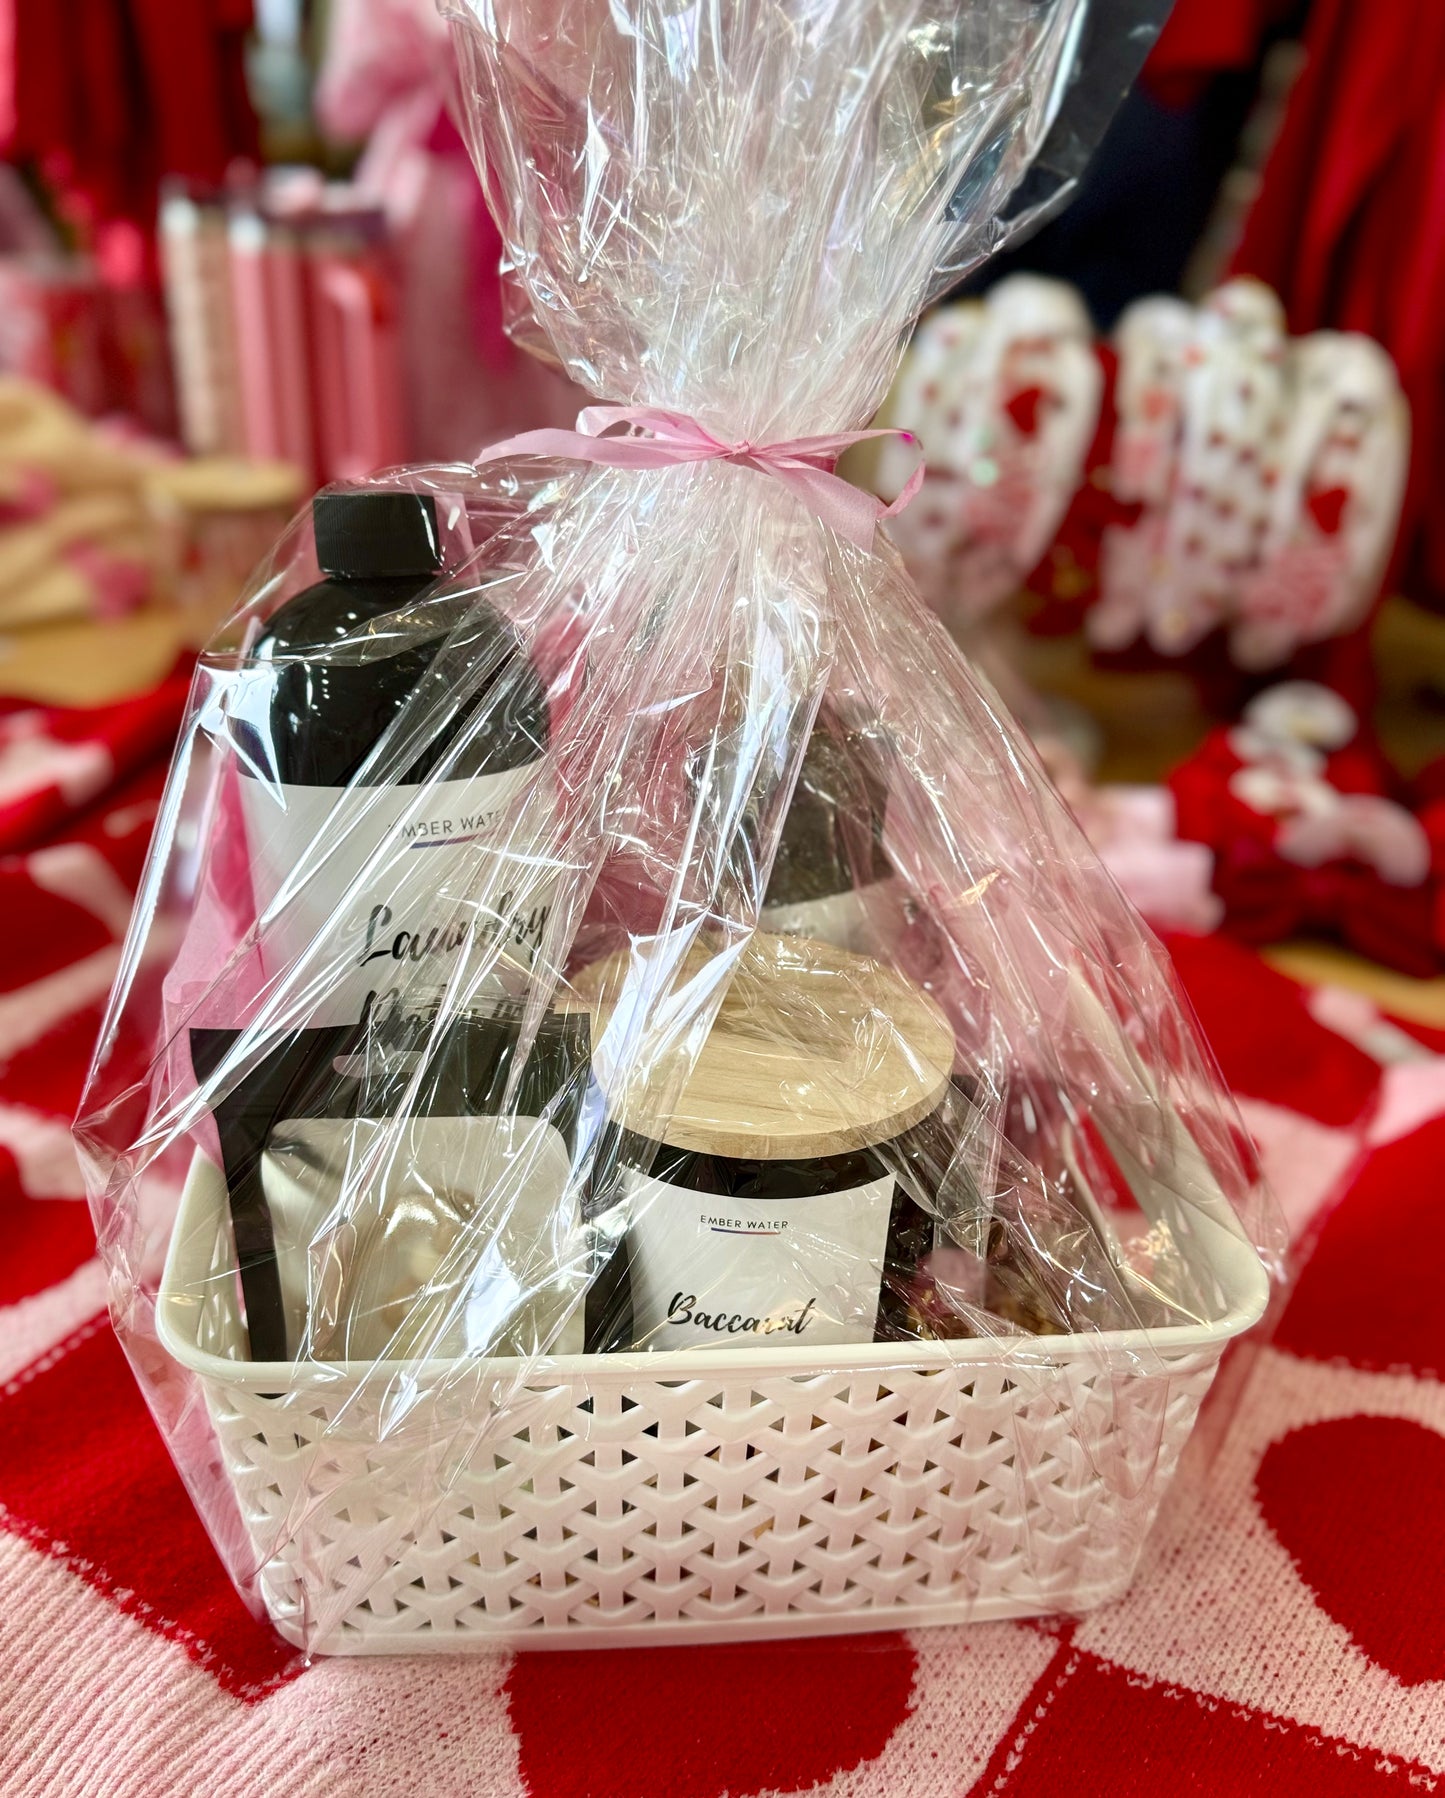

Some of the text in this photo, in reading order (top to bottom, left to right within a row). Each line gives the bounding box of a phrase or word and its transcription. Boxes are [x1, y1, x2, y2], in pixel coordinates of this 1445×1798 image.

[388, 820, 453, 838] MBER
[700, 1215, 789, 1230] EMBER WATER
